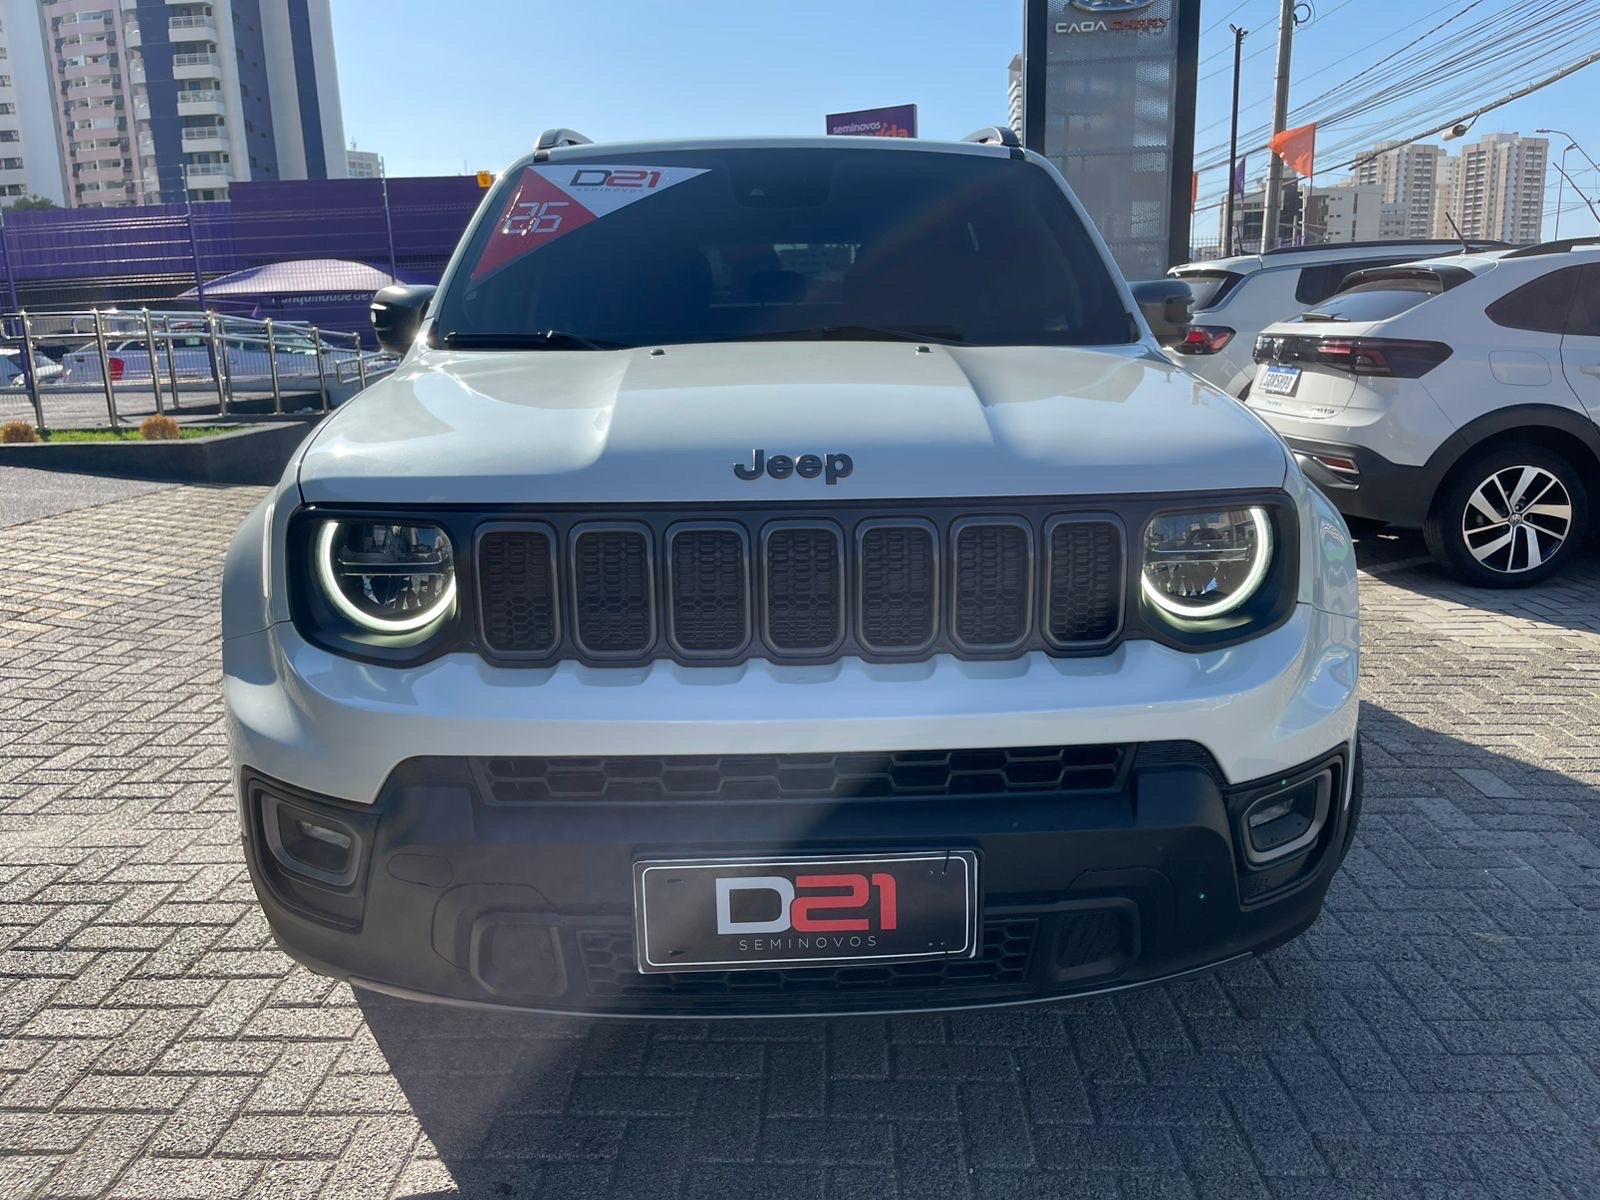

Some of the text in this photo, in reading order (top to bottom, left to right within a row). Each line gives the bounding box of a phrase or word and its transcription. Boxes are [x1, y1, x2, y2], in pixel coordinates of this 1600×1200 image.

[1055, 21, 1108, 33] CAOA
[832, 121, 882, 135] seminovos
[569, 169, 662, 188] D21
[733, 448, 854, 485] Jeep
[715, 873, 897, 935] D21
[738, 935, 878, 951] SEMINOVOS
